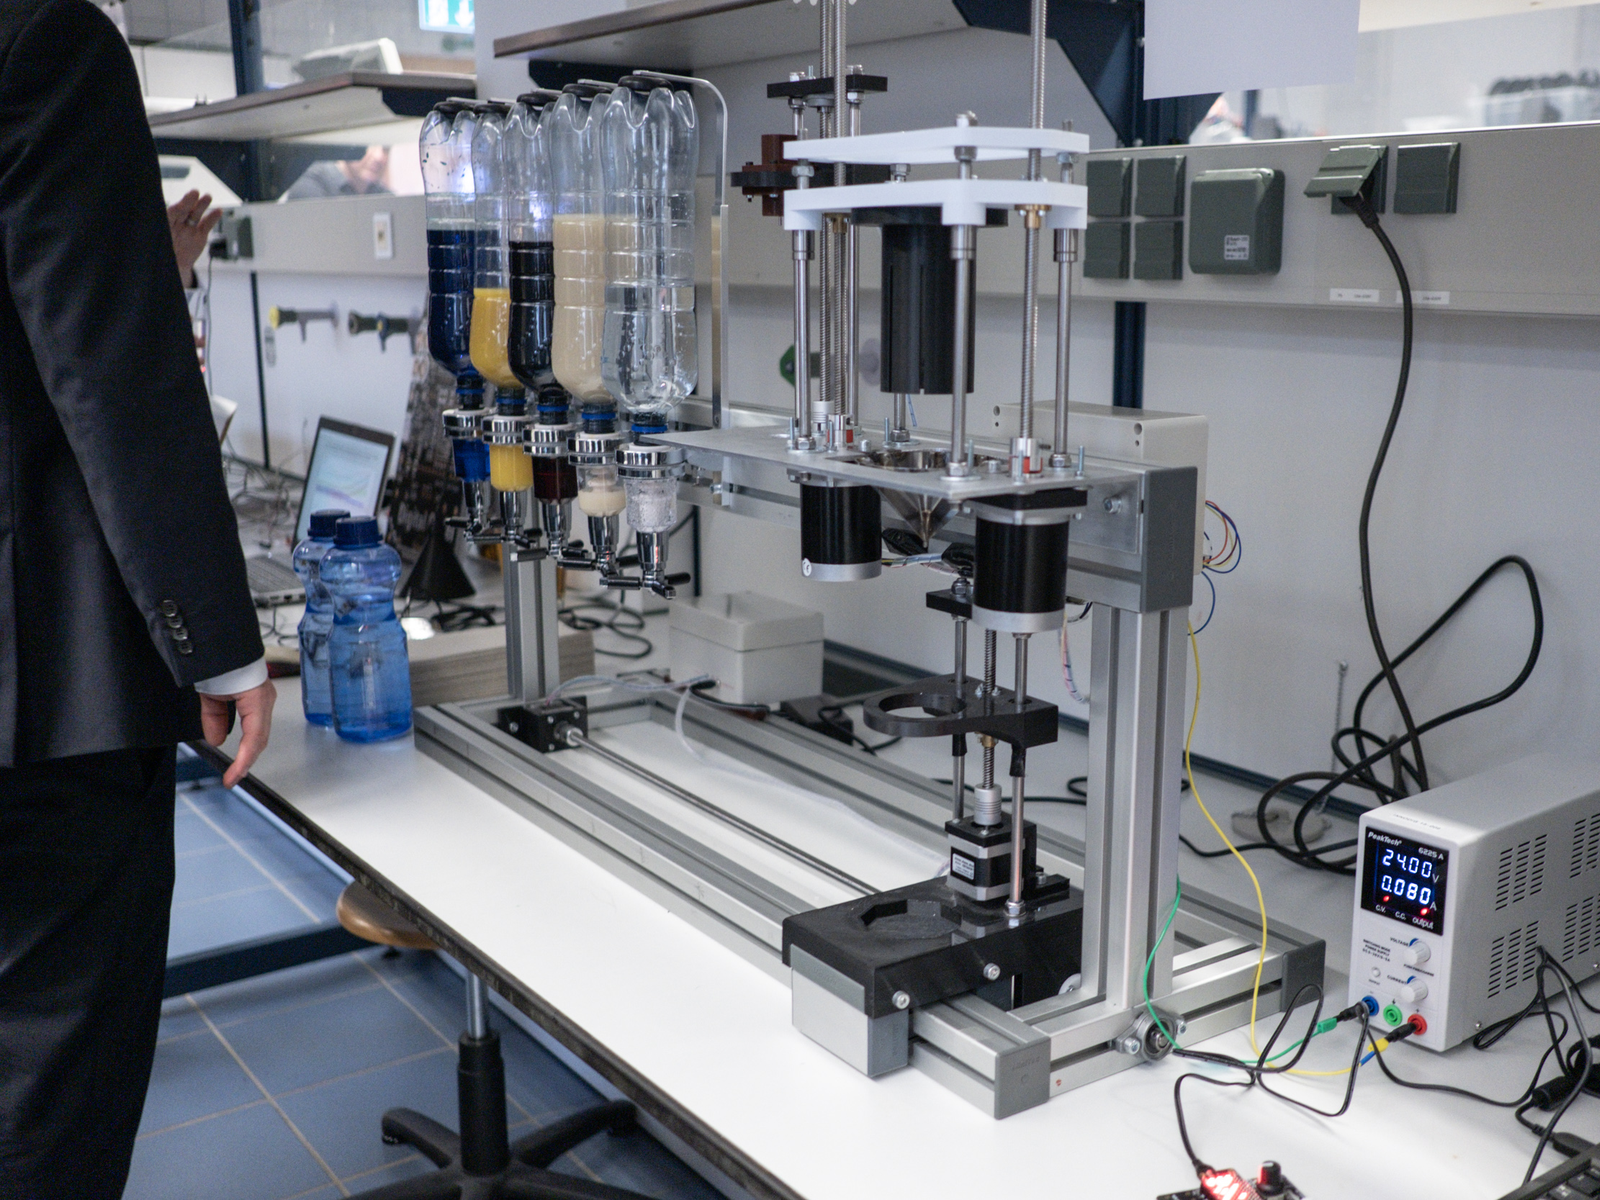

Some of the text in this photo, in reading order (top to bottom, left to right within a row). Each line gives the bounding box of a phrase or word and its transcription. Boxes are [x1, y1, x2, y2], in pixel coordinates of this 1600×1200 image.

[1418, 847, 1437, 858] 6225
[1382, 848, 1440, 883] 24.00 V
[1381, 875, 1437, 911] 0.080 A
[1412, 916, 1434, 930] output
